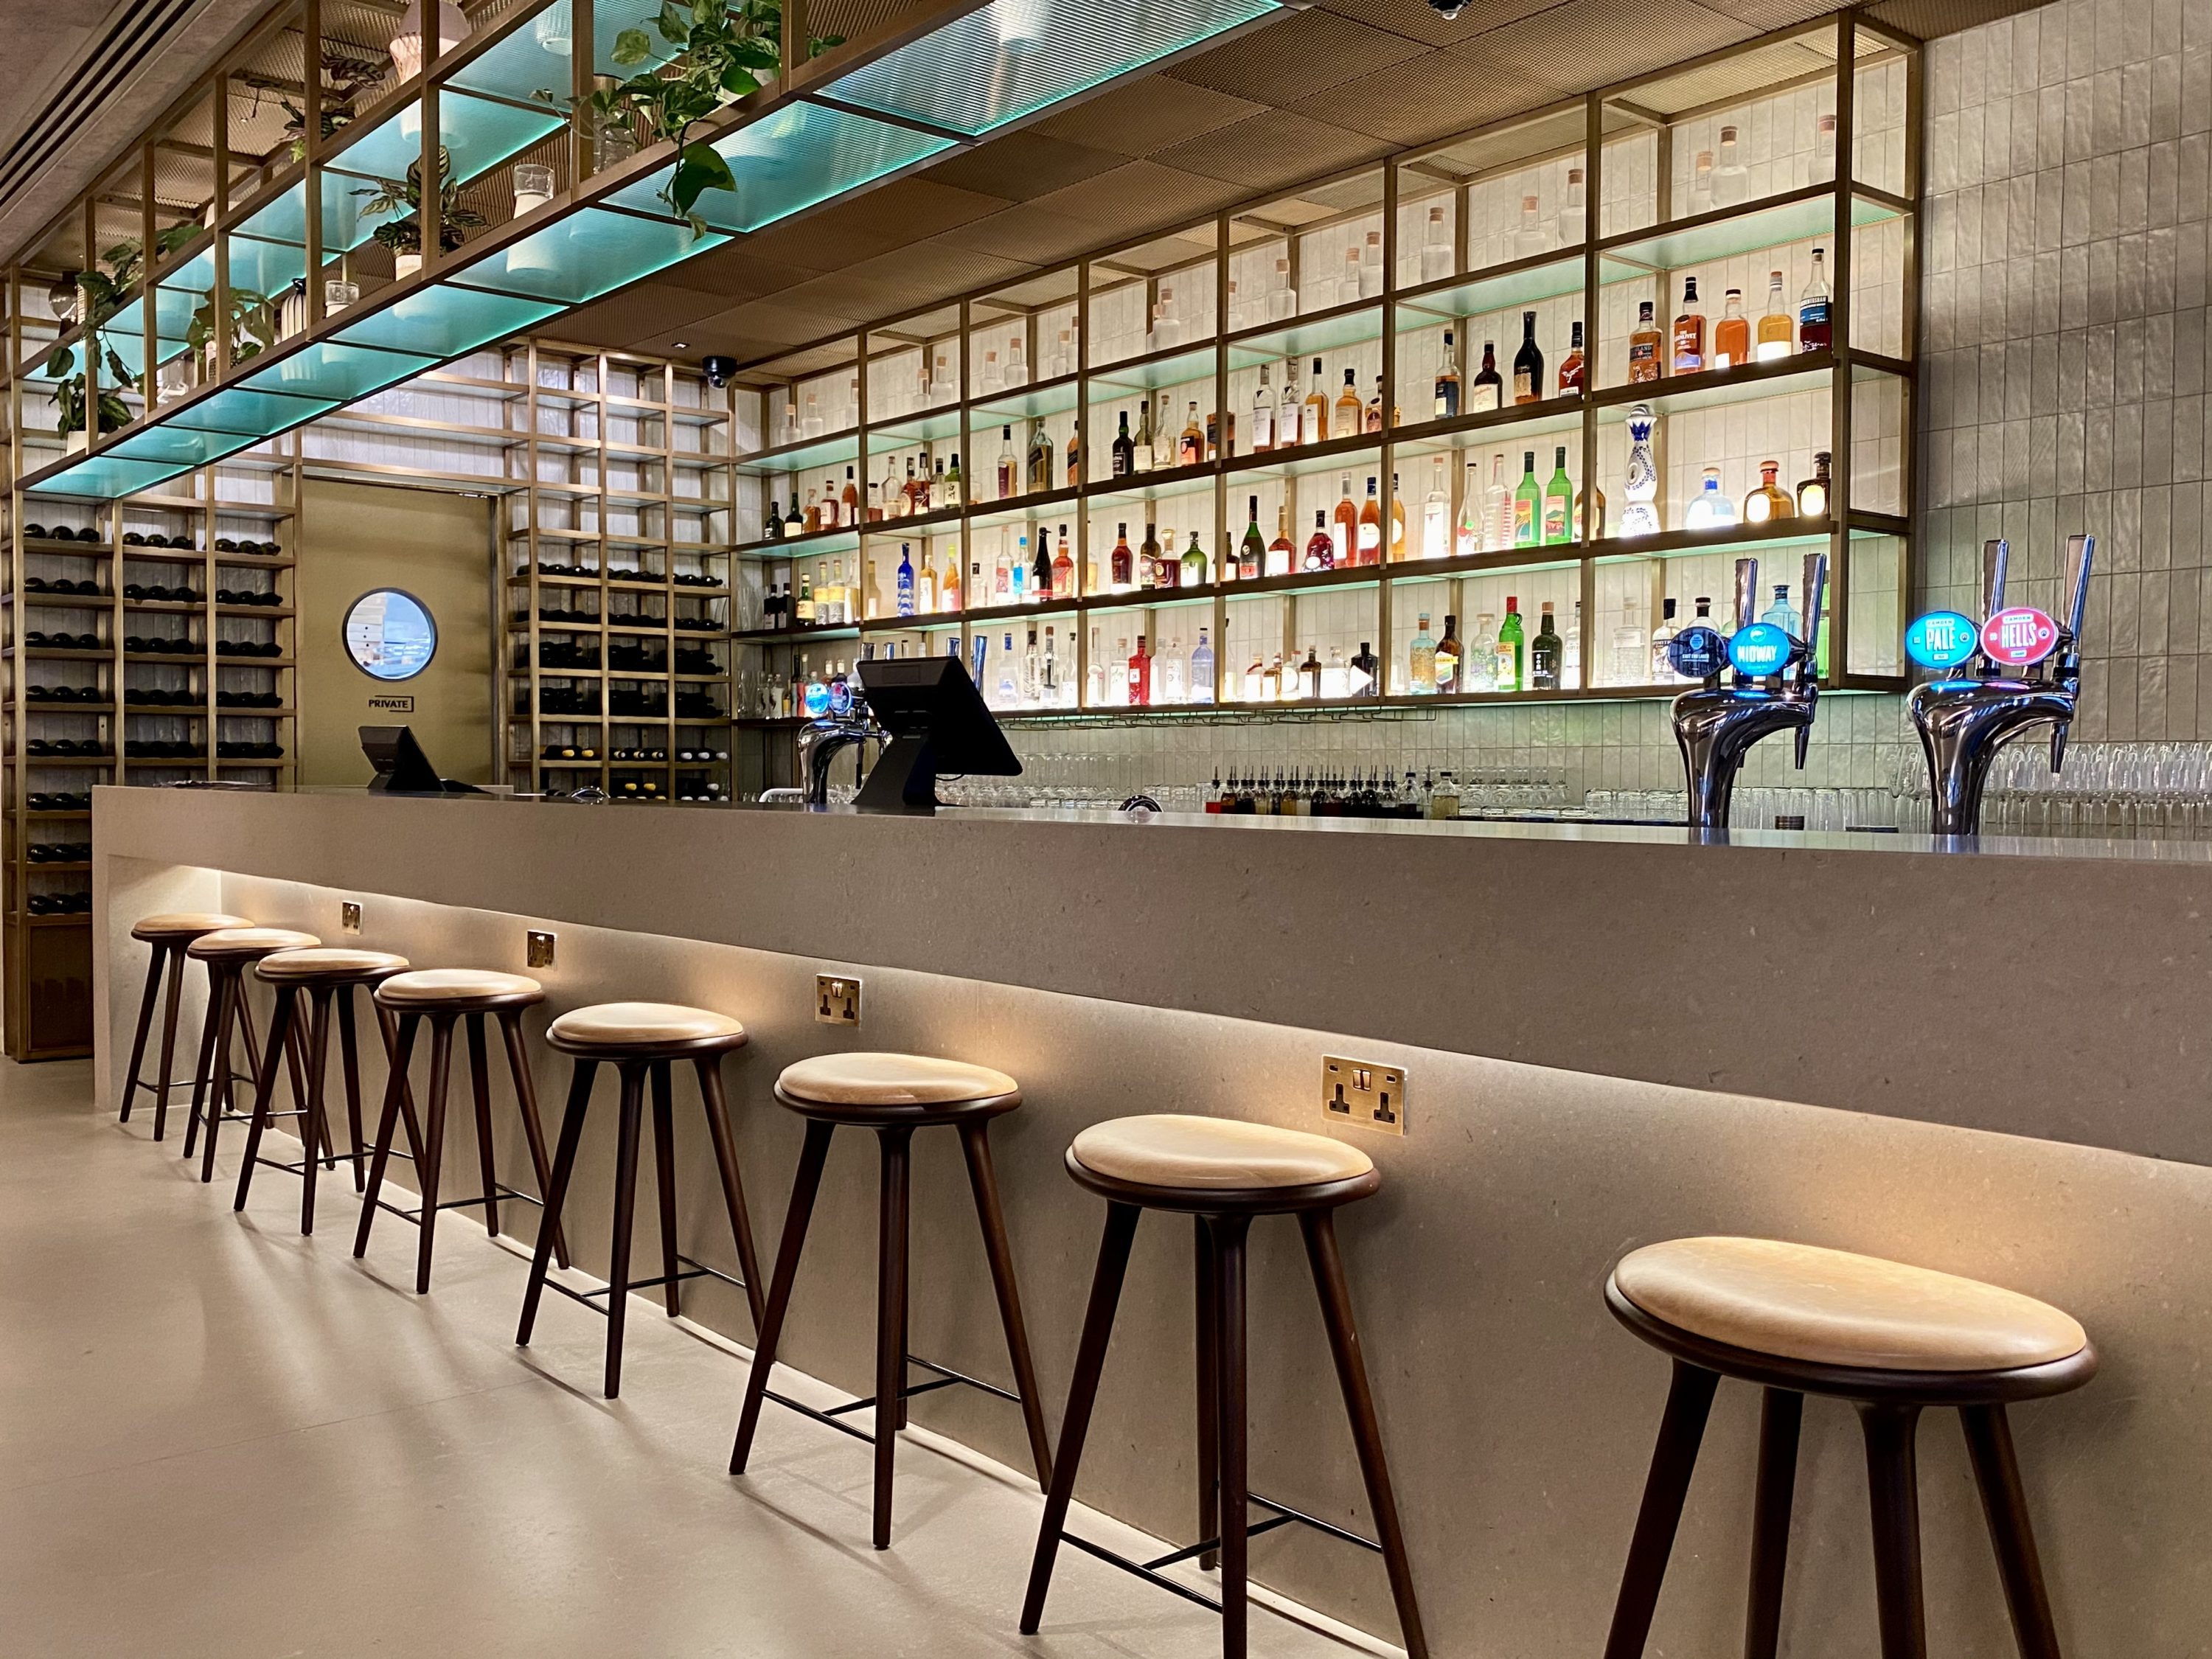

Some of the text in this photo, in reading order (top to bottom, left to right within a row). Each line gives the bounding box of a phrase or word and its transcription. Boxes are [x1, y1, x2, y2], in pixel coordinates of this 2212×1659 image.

[1925, 627, 1956, 650] PALE
[2001, 622, 2037, 649] HELLS
[1737, 645, 1777, 663] MIDWAY
[369, 700, 408, 708] PRIVATE
